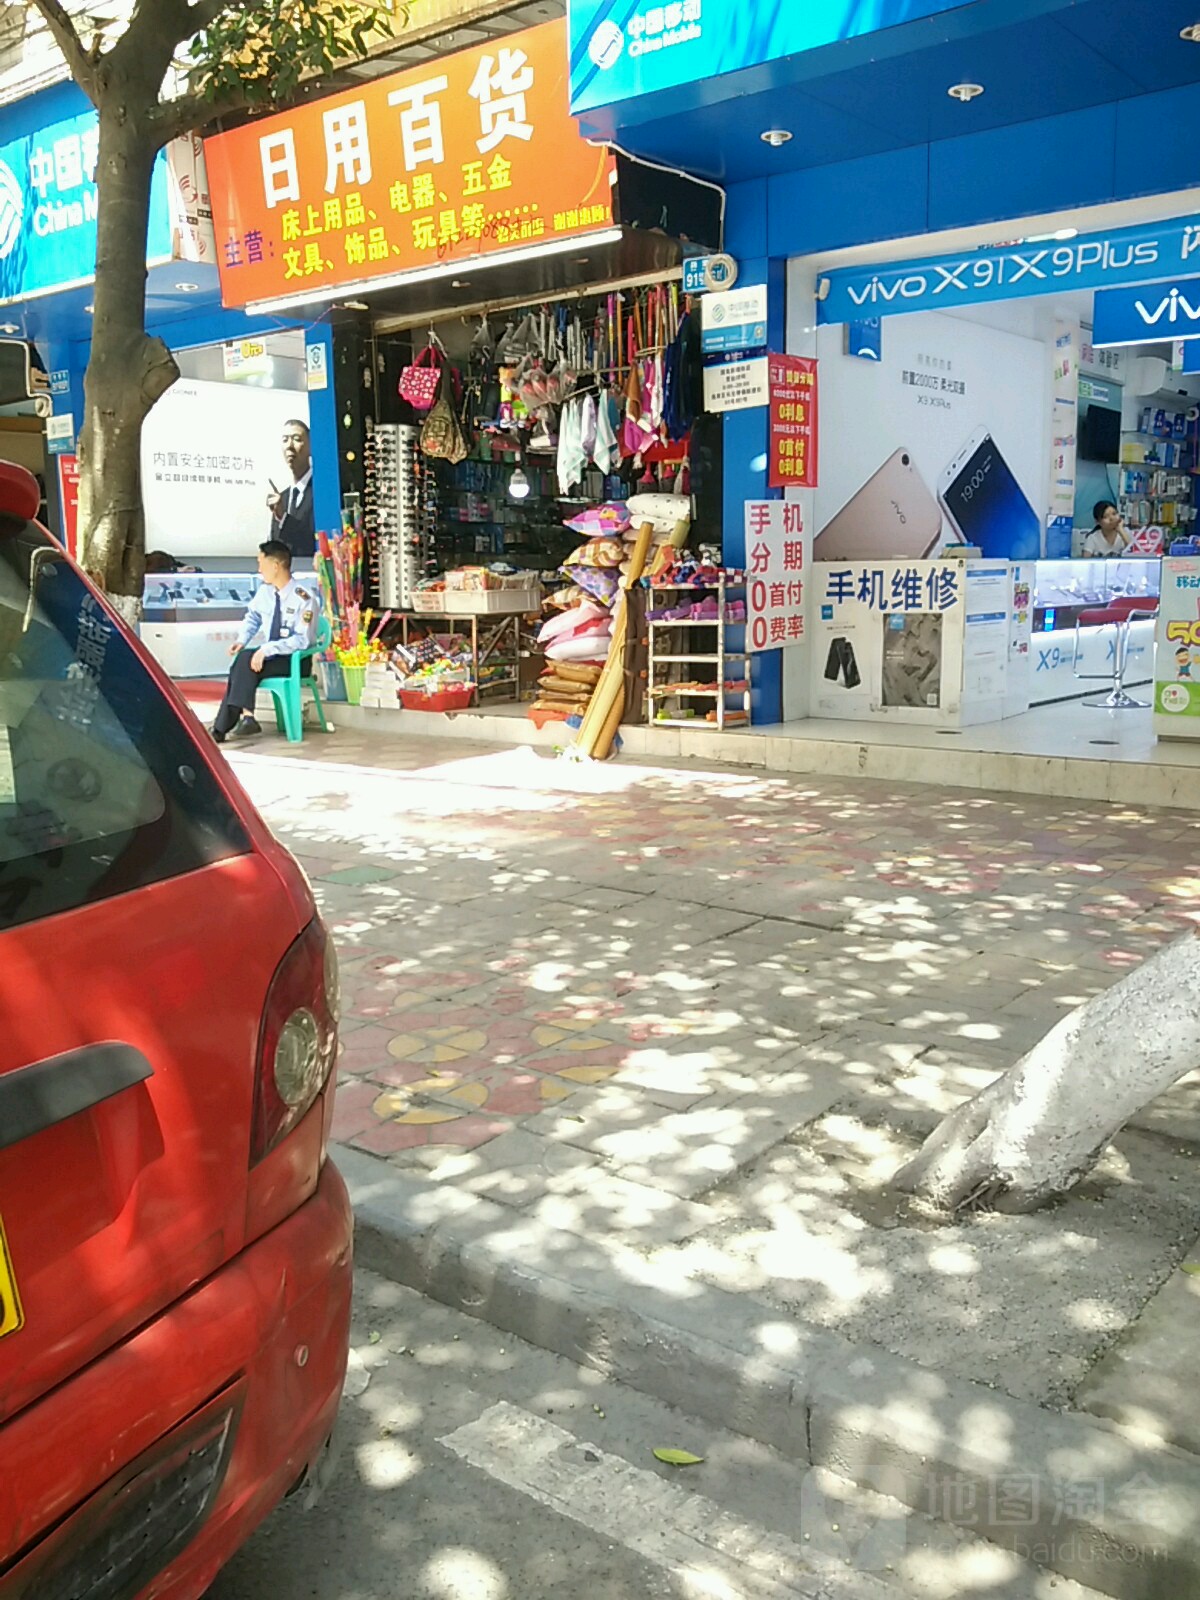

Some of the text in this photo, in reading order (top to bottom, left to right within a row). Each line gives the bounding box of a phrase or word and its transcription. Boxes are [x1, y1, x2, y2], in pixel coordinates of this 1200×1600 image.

[259, 48, 533, 209] 日用百货
[33, 200, 83, 236] China
[847, 276, 927, 306] vivo
[153, 452, 254, 470] 内置安全加密芯片
[749, 503, 803, 534] 手机
[751, 541, 803, 573] 分期
[751, 580, 804, 613] 0首付
[826, 566, 959, 611] 手机维修
[752, 614, 804, 648] 0费率
